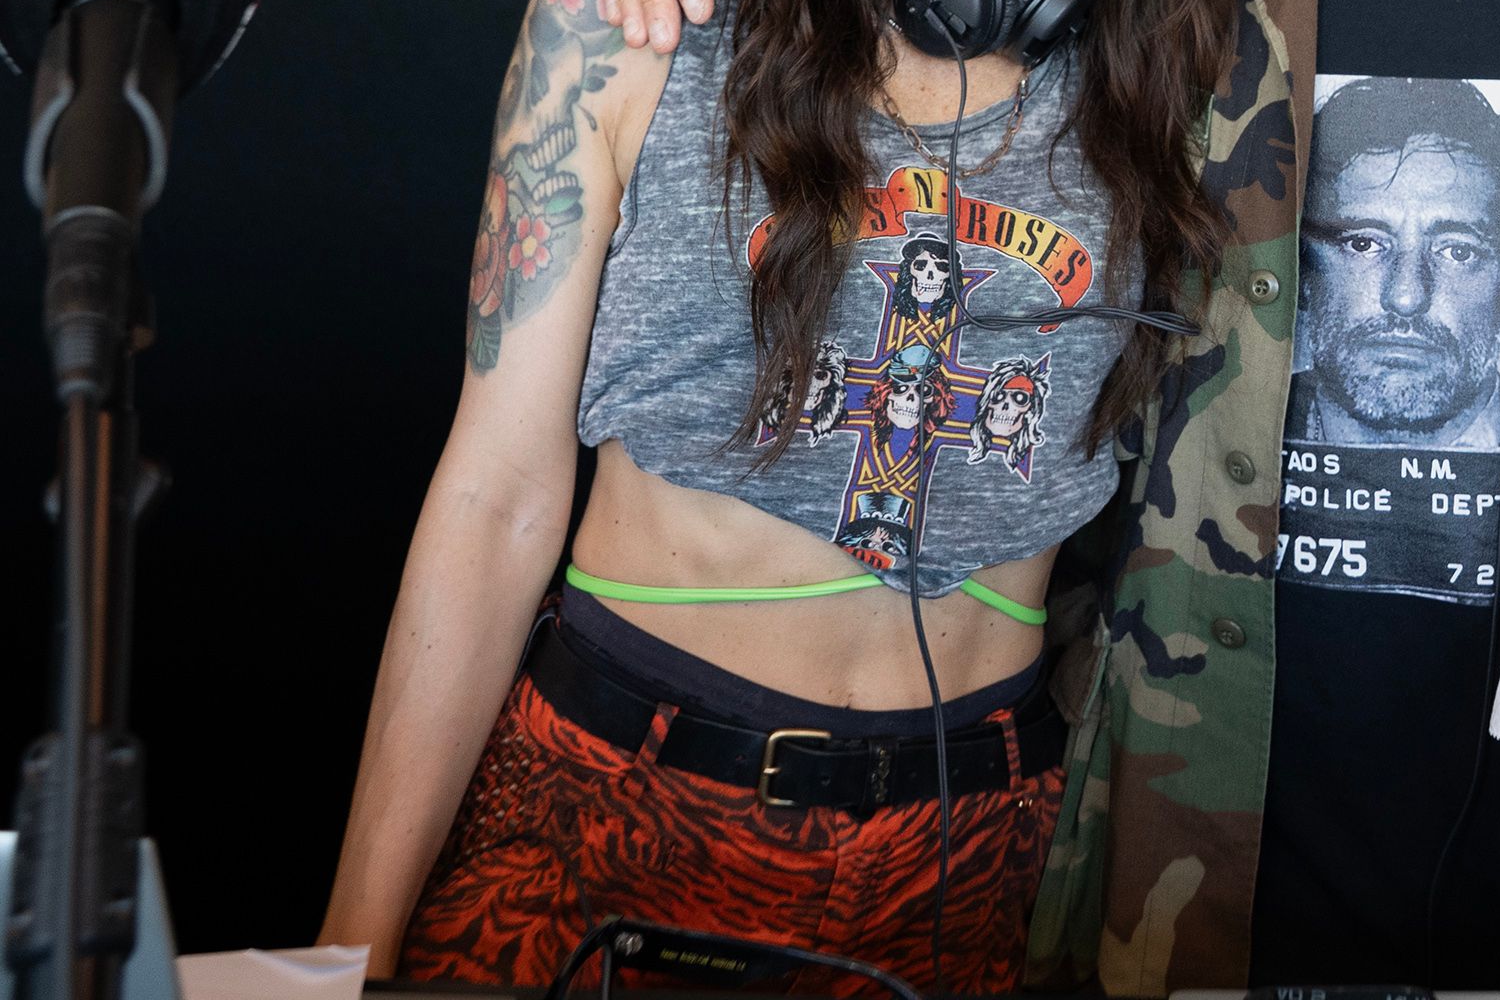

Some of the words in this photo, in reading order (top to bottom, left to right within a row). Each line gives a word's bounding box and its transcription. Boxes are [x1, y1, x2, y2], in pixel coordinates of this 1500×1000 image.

[966, 201, 1088, 287] ROSES
[1284, 483, 1393, 511] POLICE
[1276, 533, 1368, 578] 7675
